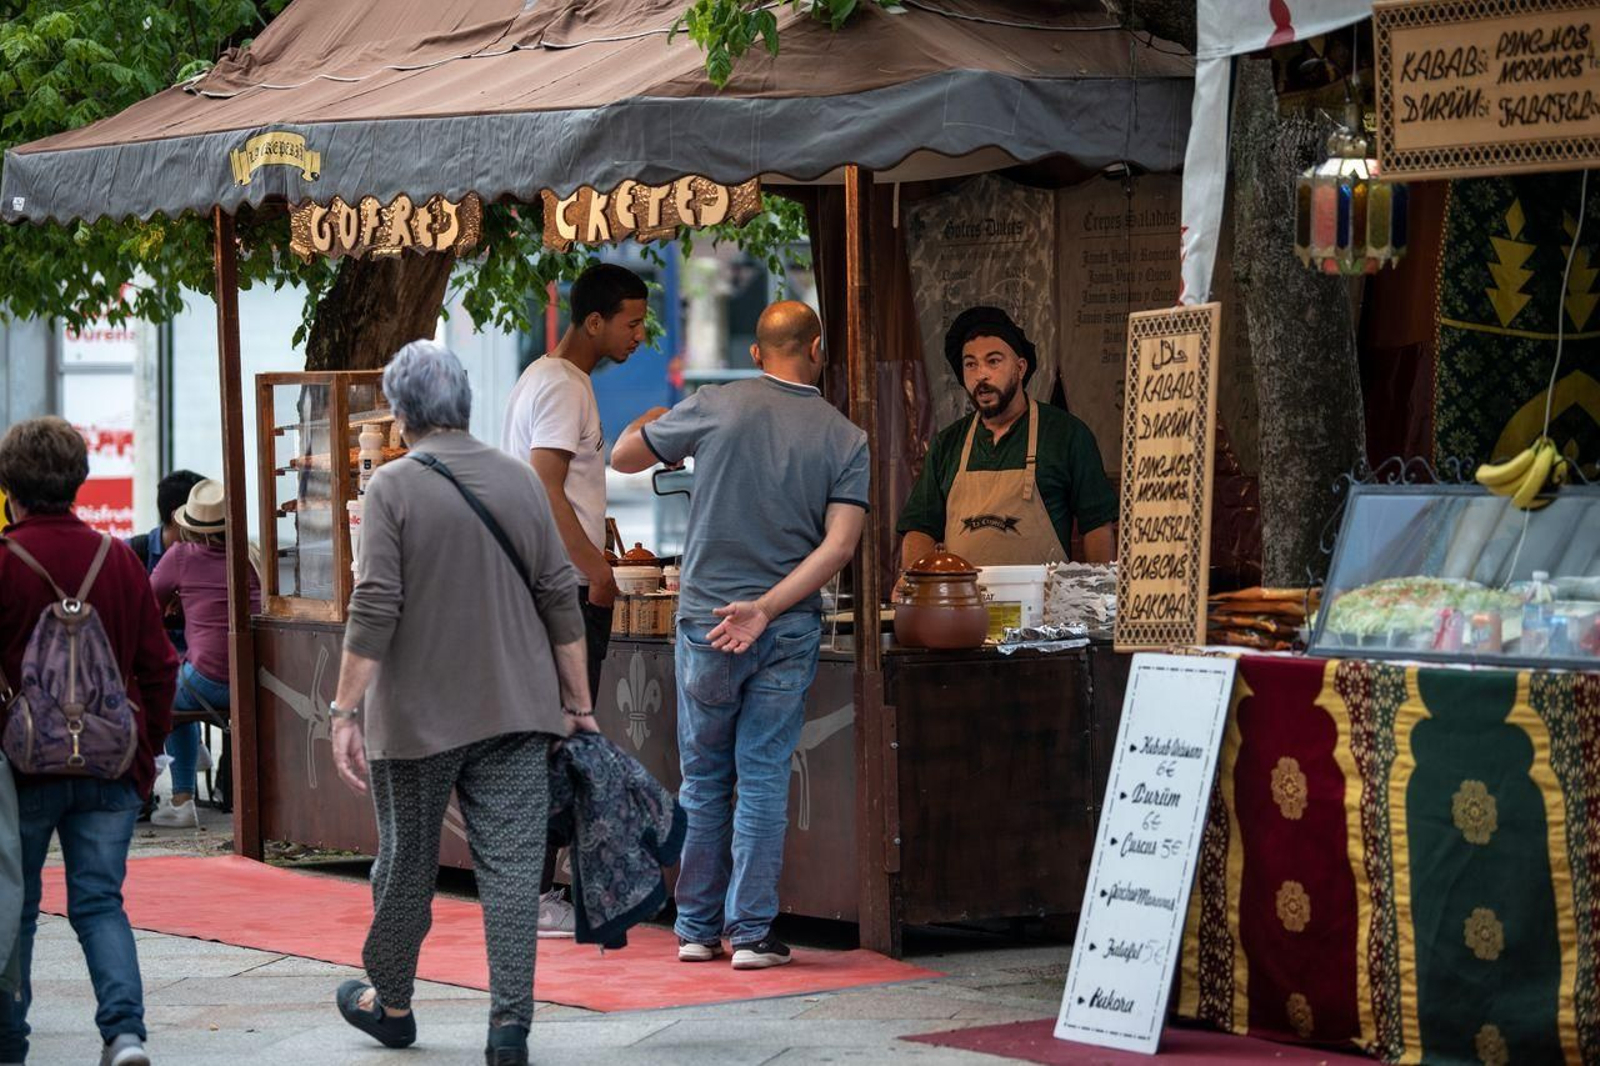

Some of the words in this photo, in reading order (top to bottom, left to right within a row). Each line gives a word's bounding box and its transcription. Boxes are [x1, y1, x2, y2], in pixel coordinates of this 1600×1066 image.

[1401, 45, 1478, 83] KABAB
[1401, 86, 1481, 123] DURÜM
[1141, 371, 1195, 403] KABAB
[1130, 553, 1188, 580] CUSCUS
[1156, 760, 1178, 778] 6€
[1142, 811, 1162, 831] 6€
